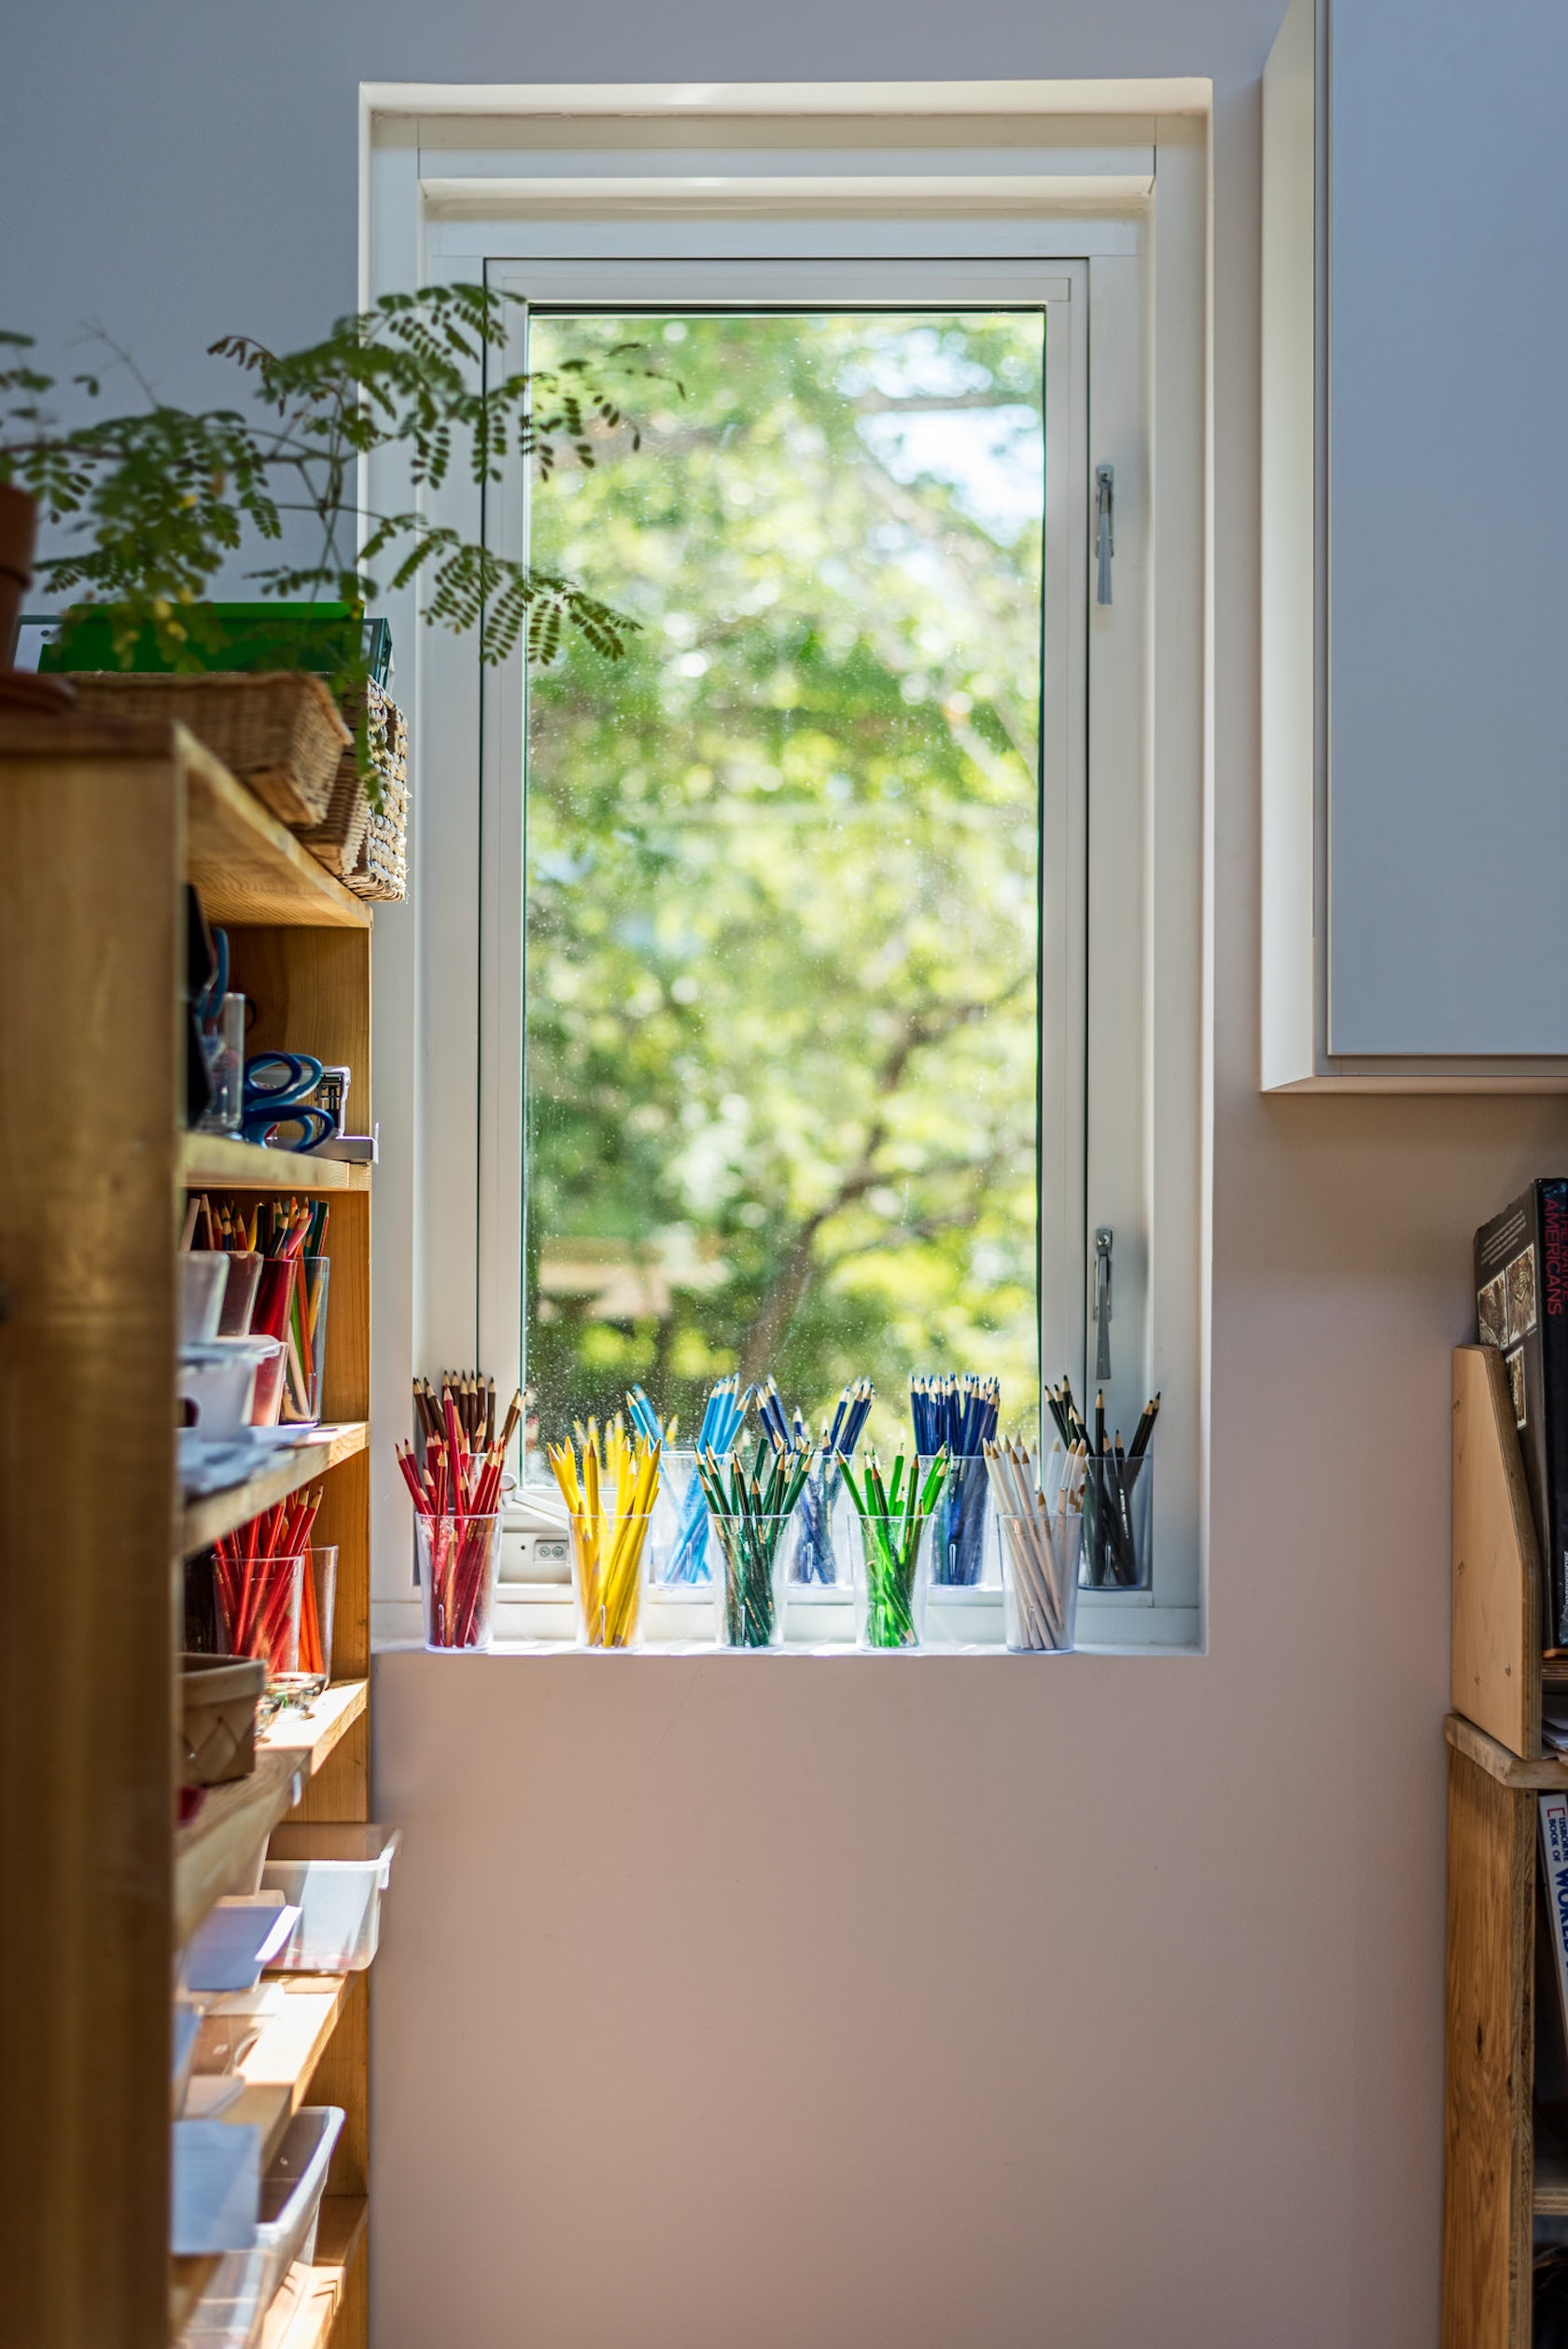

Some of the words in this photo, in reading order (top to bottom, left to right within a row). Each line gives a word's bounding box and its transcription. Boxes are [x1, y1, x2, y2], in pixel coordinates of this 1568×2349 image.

[1545, 1197, 1562, 1315] AMERICANS
[1548, 1818, 1559, 1847] BOOK
[1559, 1816, 1568, 1862] USBORNE
[1552, 1850, 1561, 1863] OF
